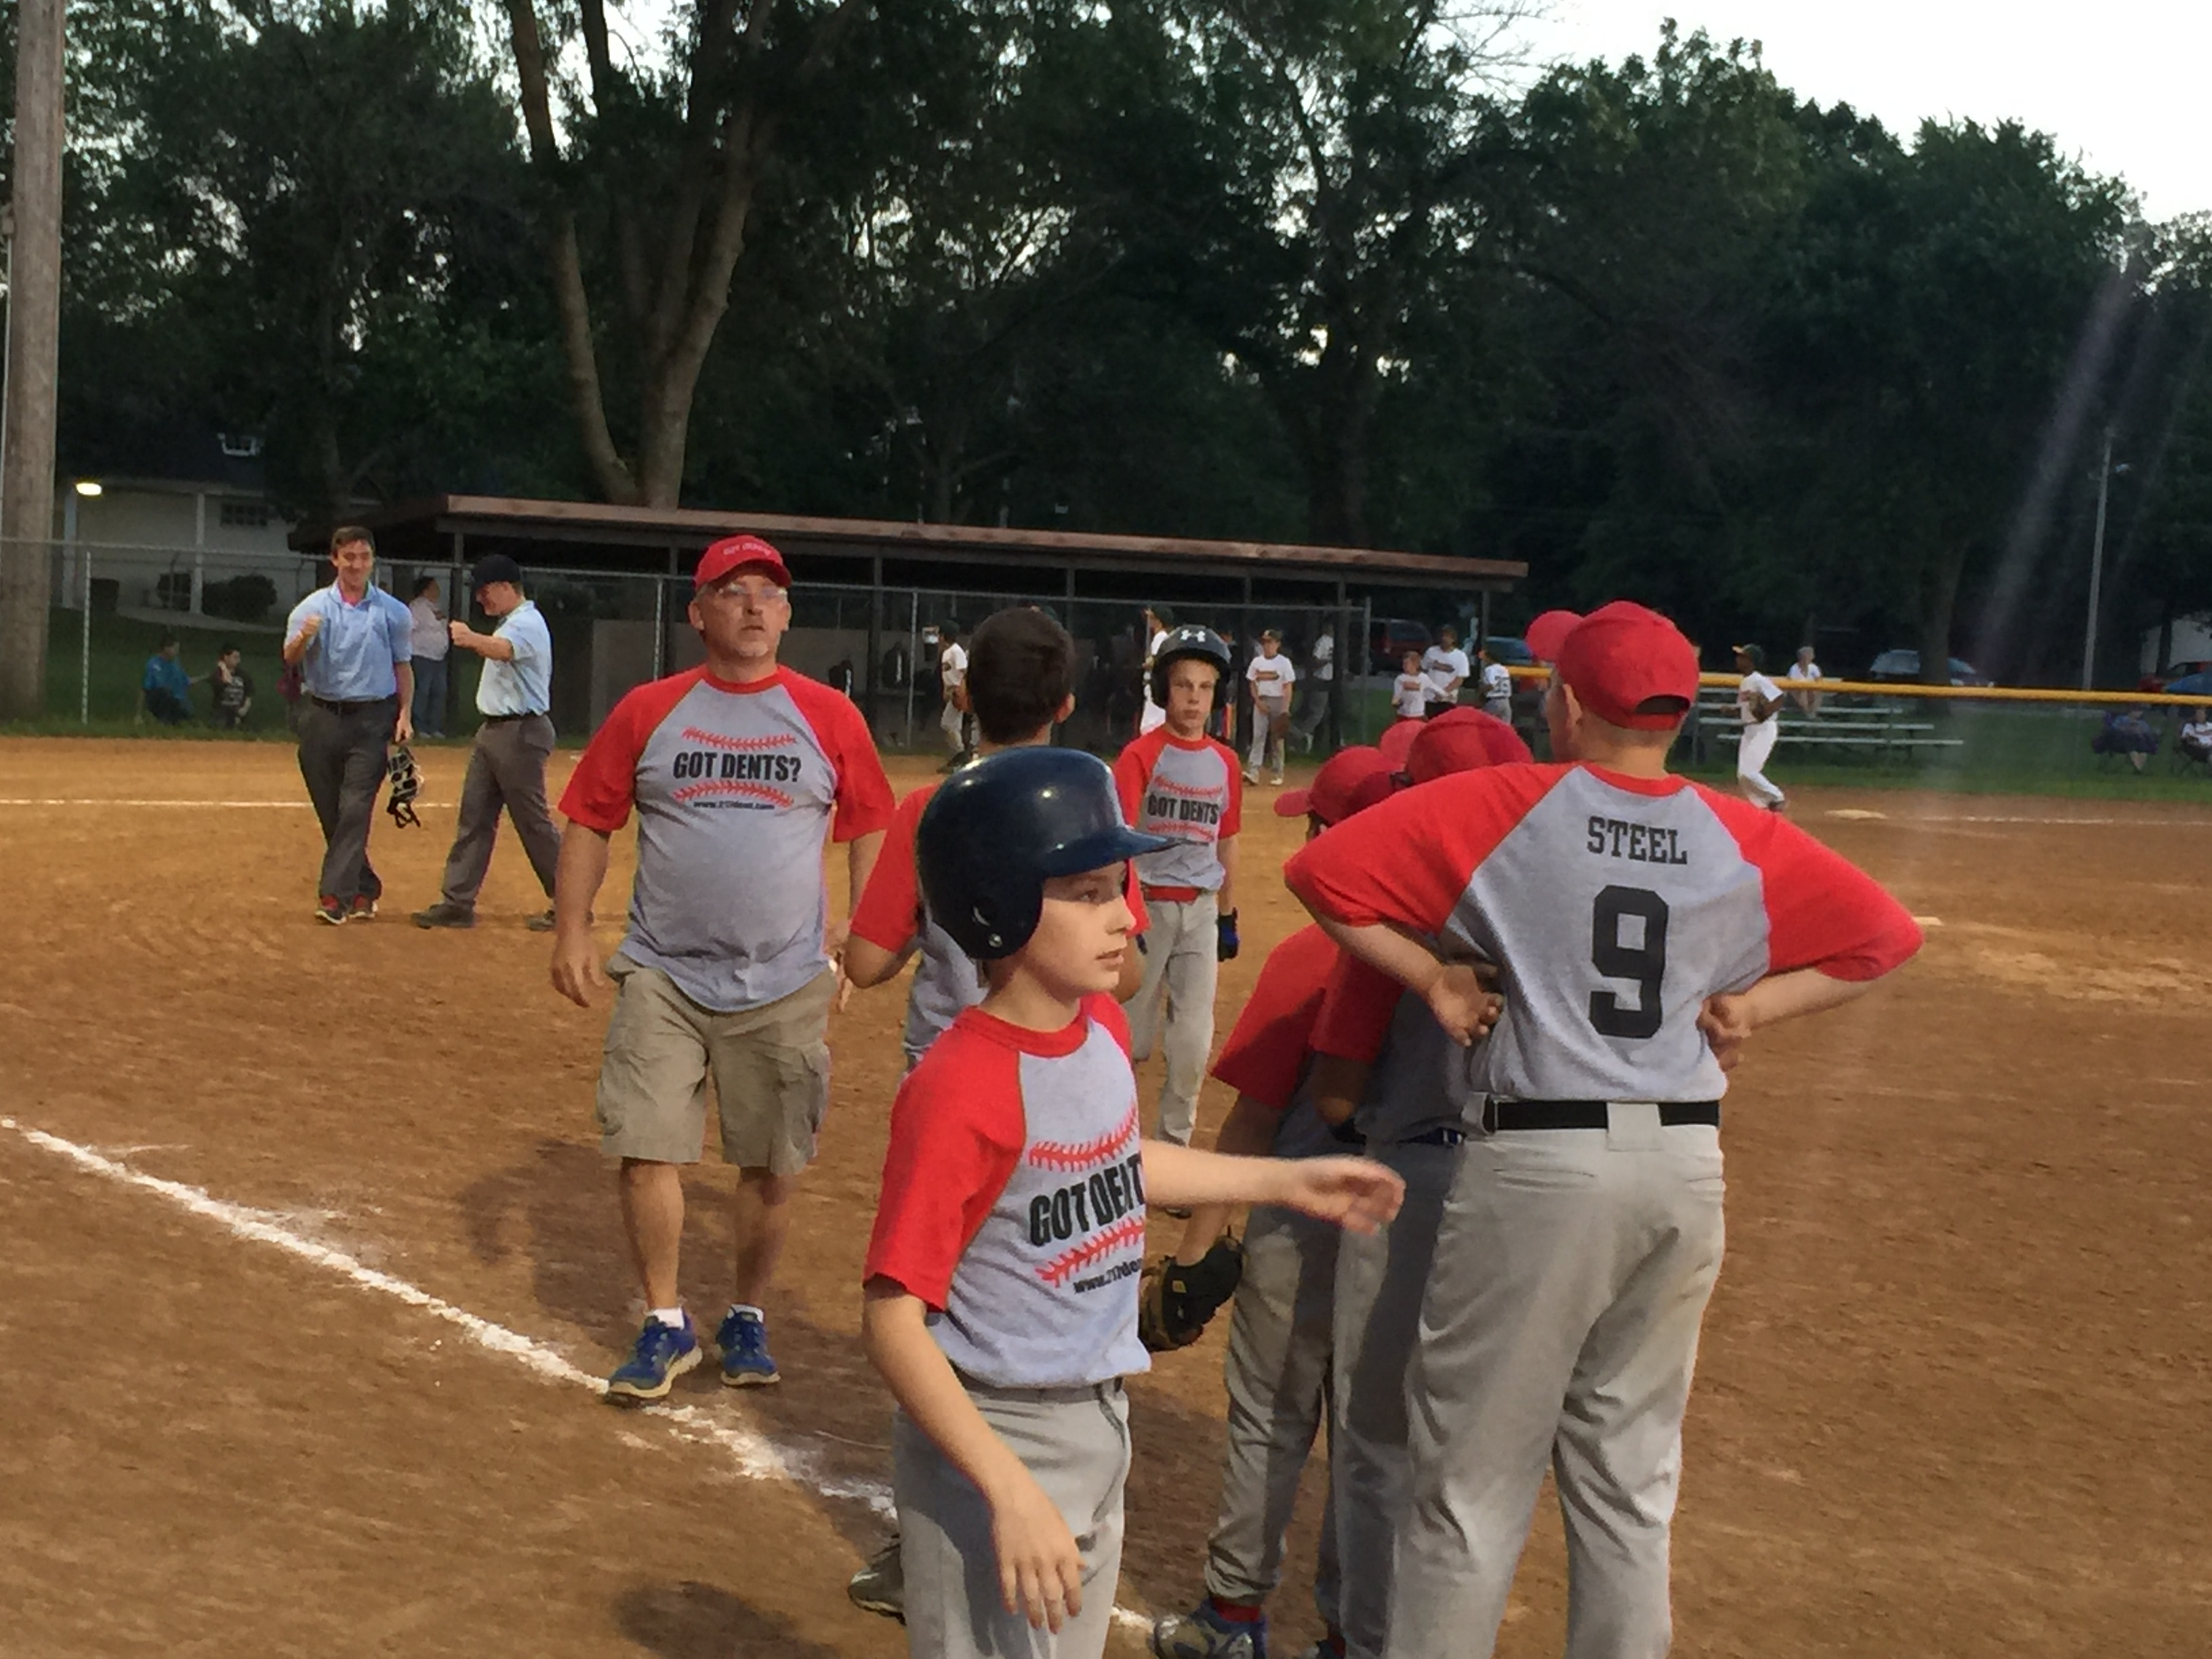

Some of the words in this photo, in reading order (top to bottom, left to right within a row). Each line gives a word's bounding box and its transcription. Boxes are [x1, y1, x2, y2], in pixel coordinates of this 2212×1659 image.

[673, 751, 718, 779] GOT
[720, 753, 802, 782] DENTS?
[1147, 794, 1178, 819] GOT
[1586, 815, 1687, 865] STEEL
[1588, 884, 1669, 1039] 9
[1029, 1181, 1090, 1247] GOT
